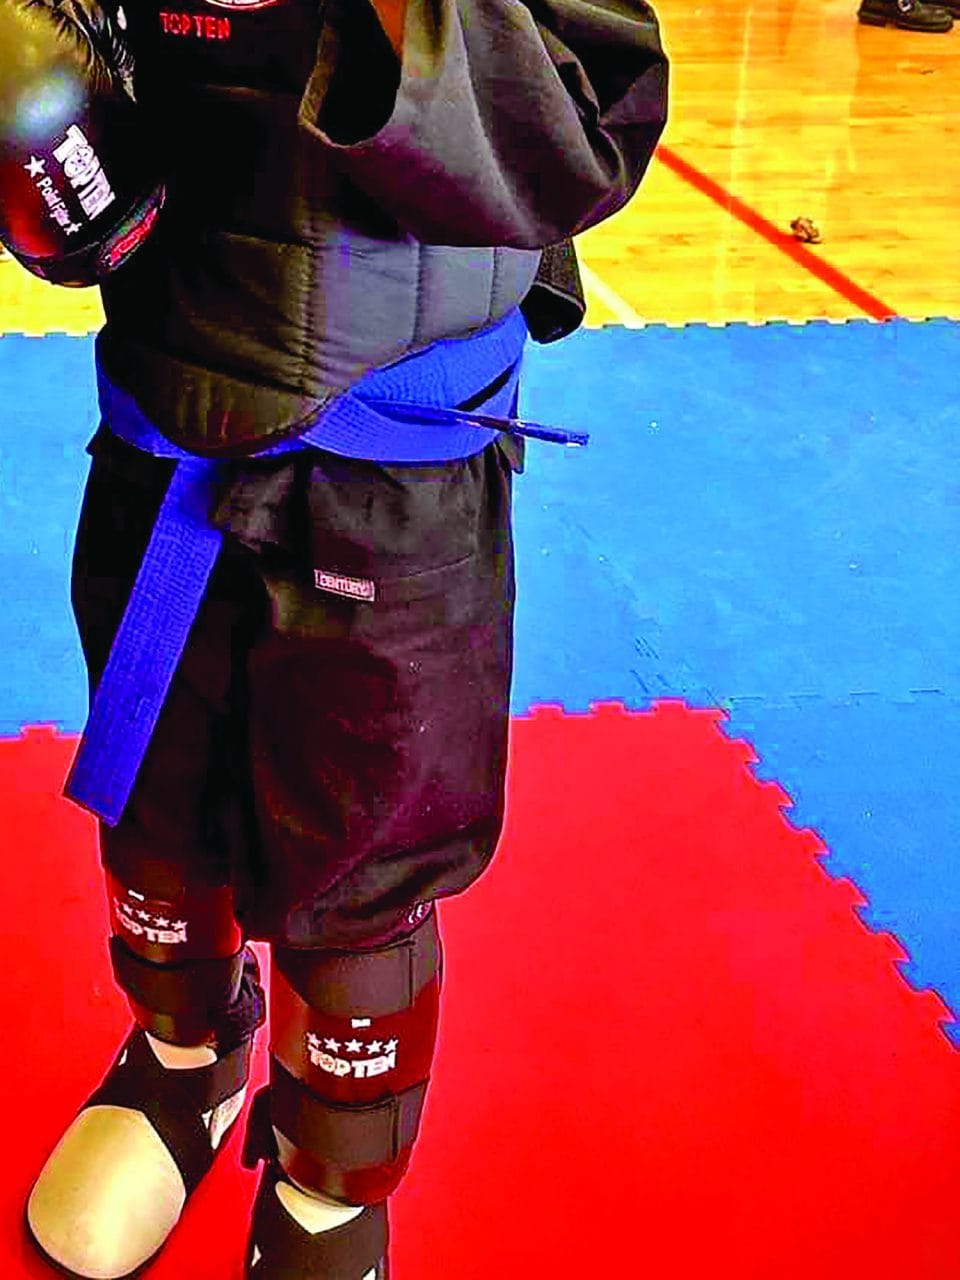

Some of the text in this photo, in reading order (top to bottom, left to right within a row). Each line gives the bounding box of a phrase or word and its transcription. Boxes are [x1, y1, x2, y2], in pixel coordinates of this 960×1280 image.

[160, 12, 231, 39] TOP TEN
[307, 1043, 396, 1078] TOP TEN
